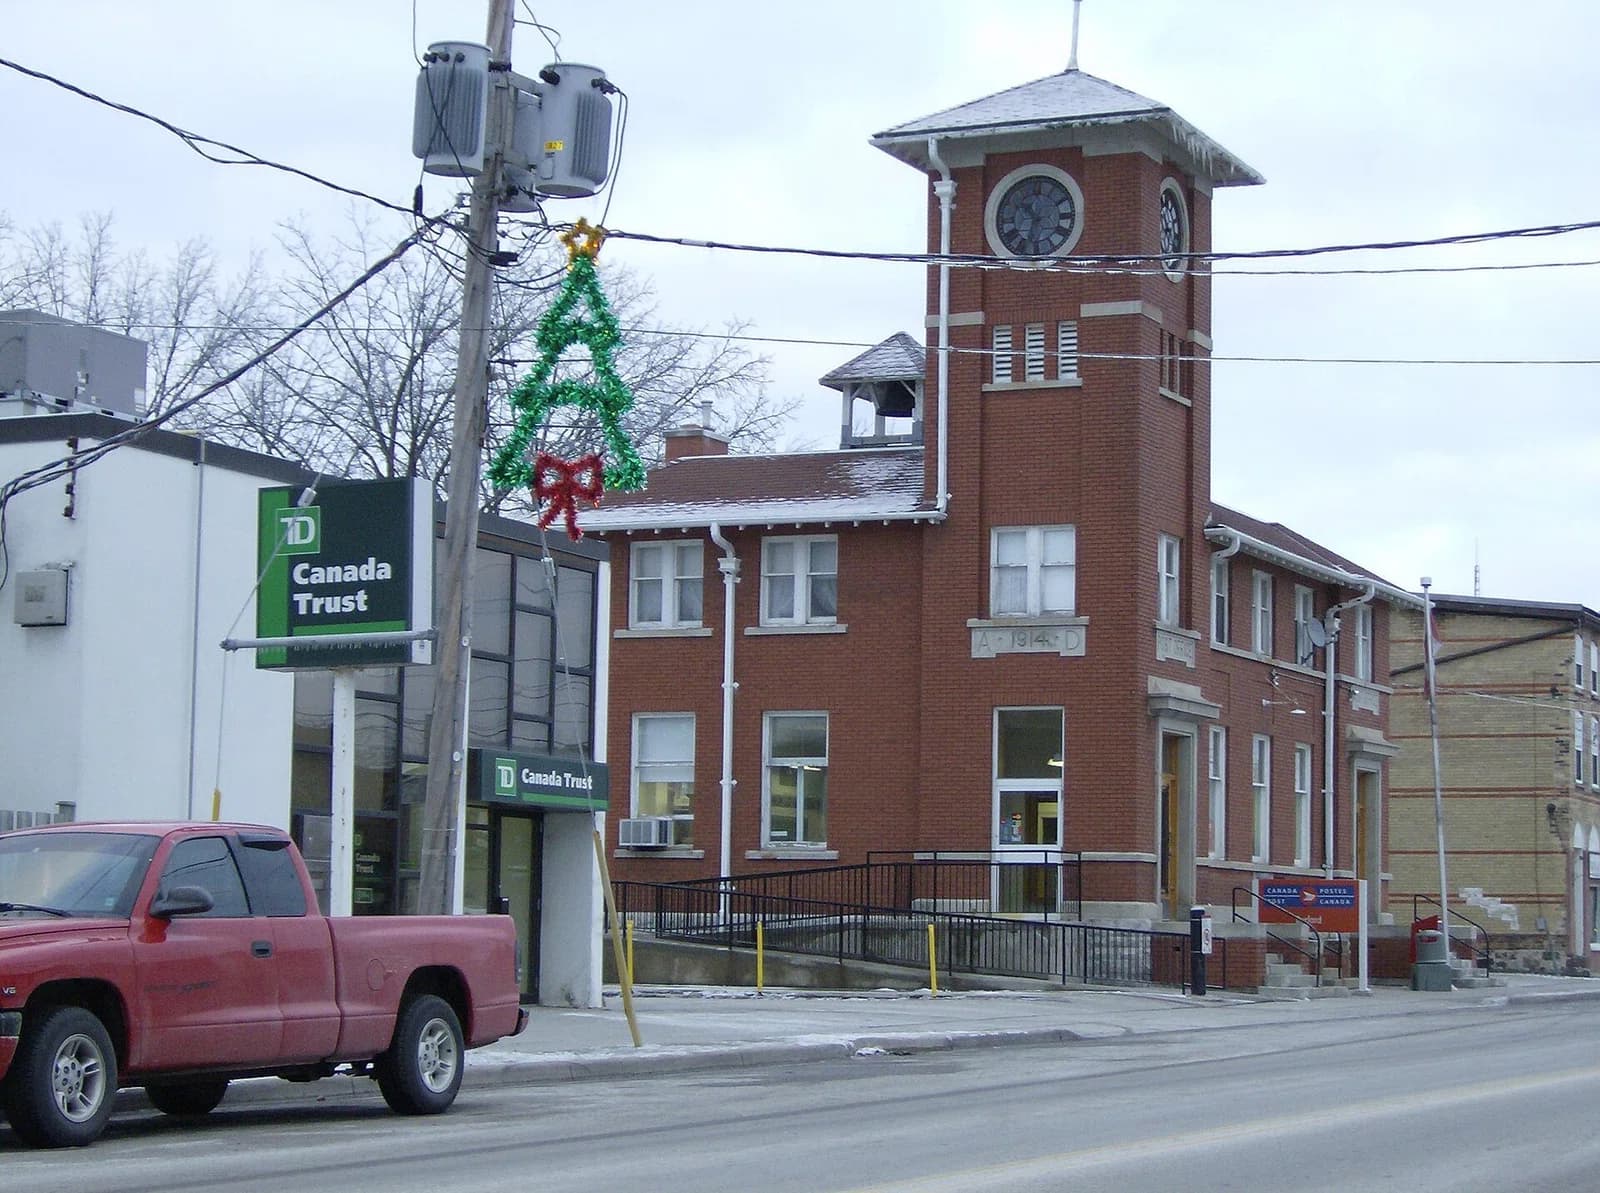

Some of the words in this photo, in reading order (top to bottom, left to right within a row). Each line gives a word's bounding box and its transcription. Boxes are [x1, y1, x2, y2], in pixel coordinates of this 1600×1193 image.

[280, 516, 316, 545] TD
[292, 557, 392, 585] Canada
[293, 589, 368, 615] Trust
[497, 765, 514, 788] TD
[521, 768, 562, 787] Canada
[563, 773, 593, 790] Trust
